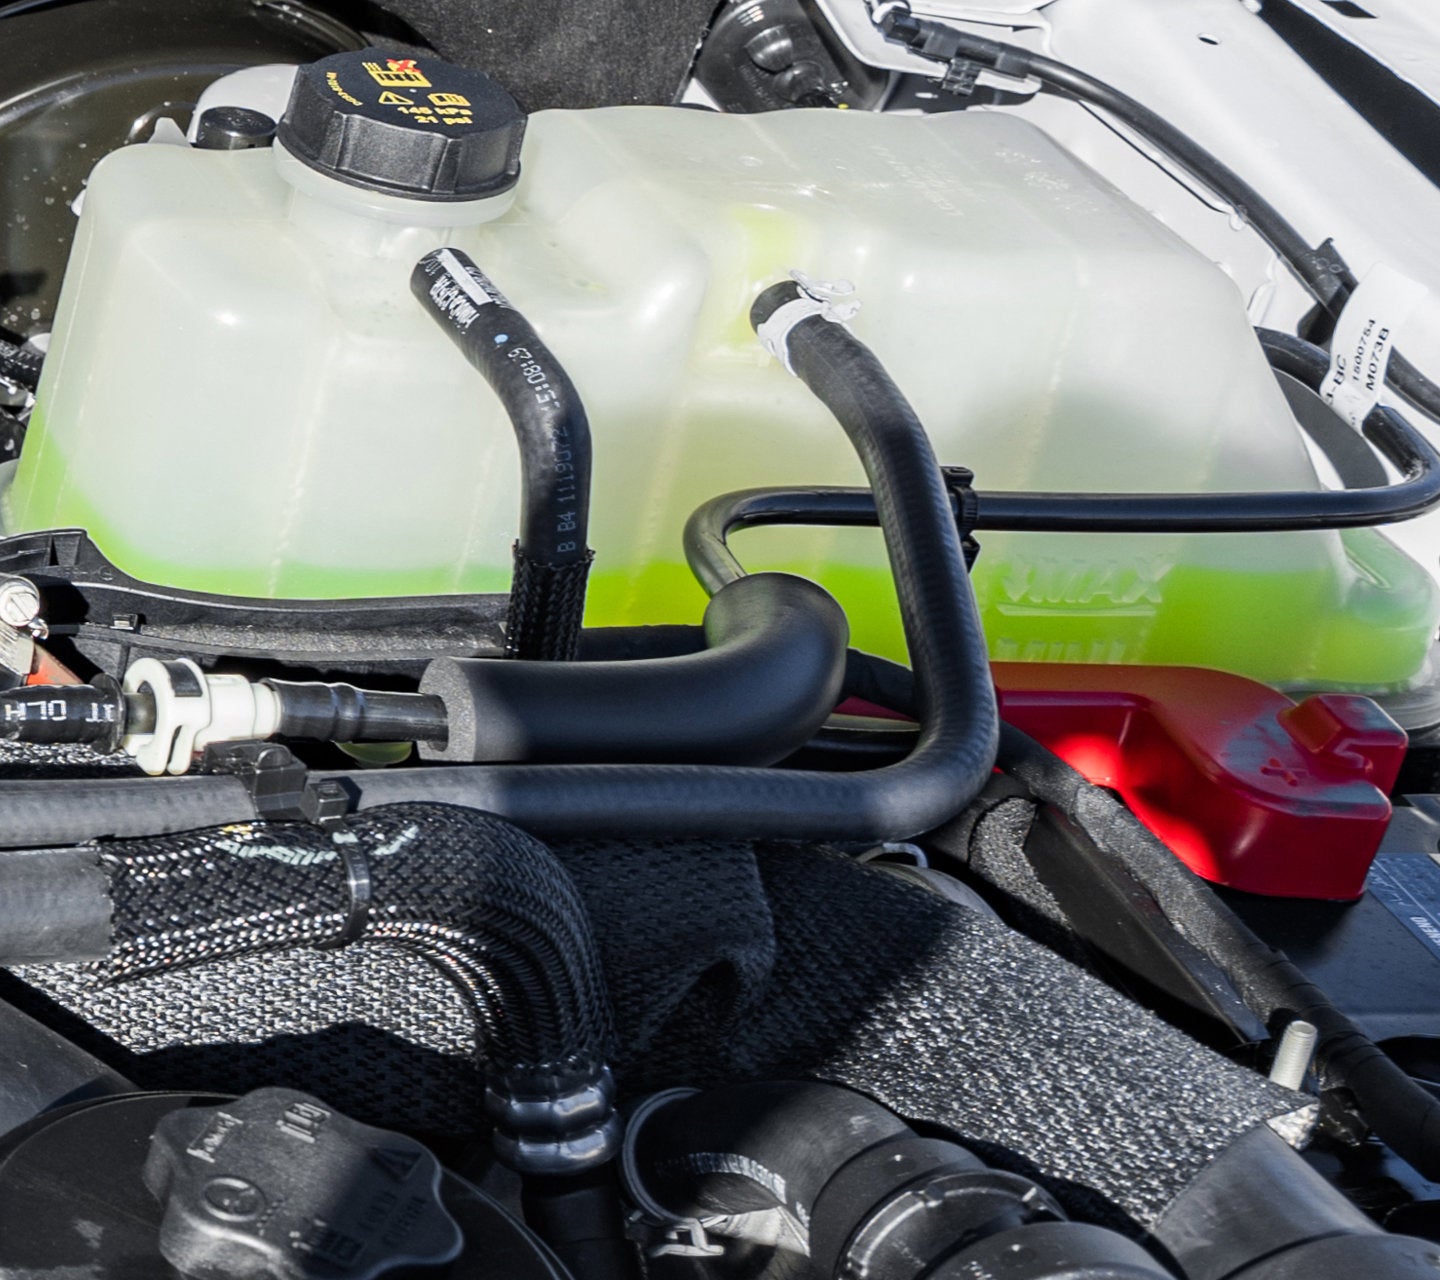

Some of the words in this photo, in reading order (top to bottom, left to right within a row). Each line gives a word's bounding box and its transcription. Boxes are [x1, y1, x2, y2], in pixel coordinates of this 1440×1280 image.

[434, 107, 473, 116] kPa
[414, 115, 438, 124] 21
[442, 116, 473, 126] psi
